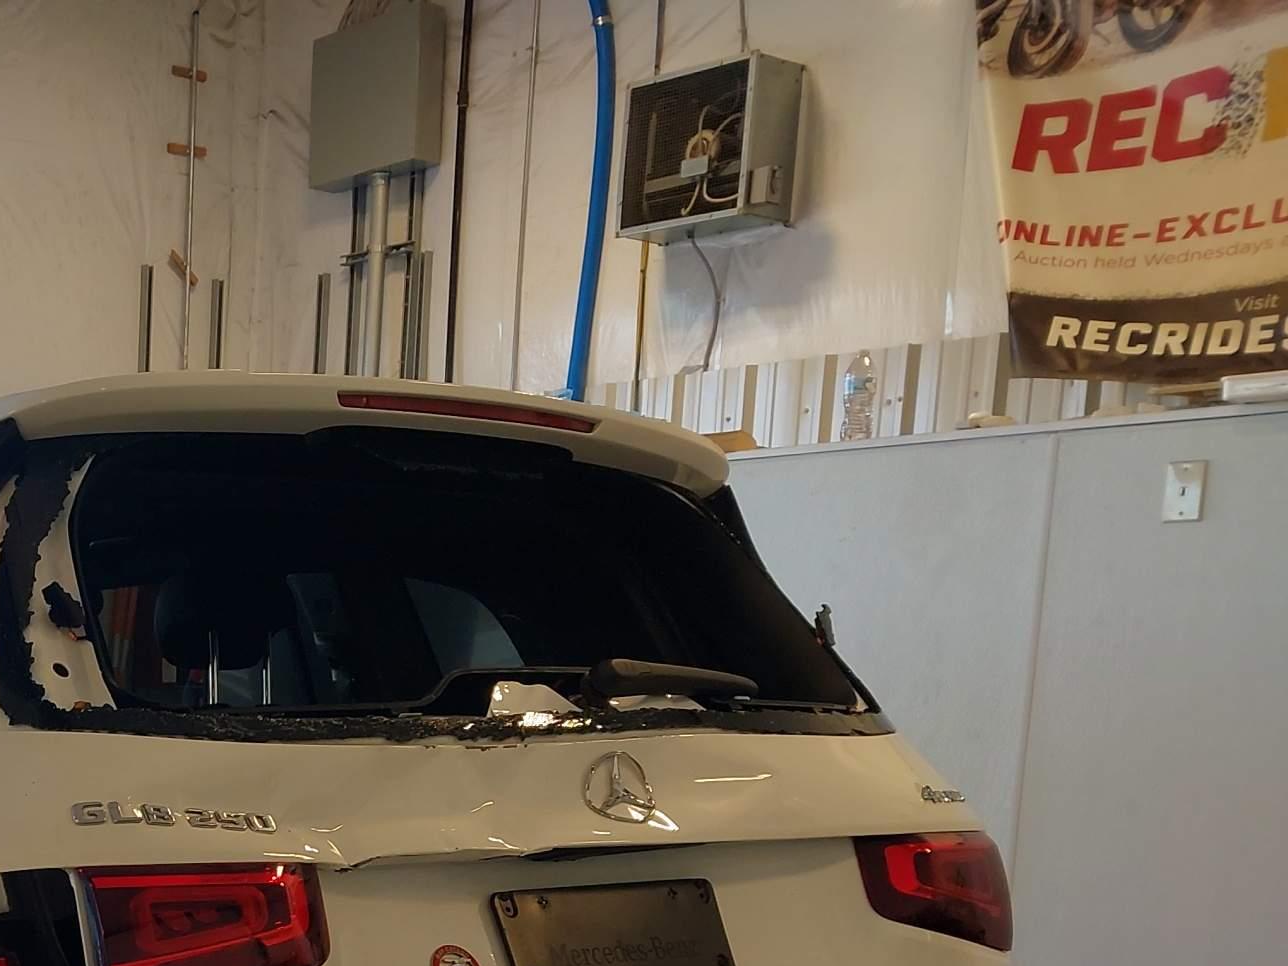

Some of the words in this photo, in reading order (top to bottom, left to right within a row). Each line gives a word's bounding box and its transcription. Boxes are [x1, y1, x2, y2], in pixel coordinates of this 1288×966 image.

[1012, 65, 1233, 174] REC
[1013, 250, 1088, 270] Auction
[1093, 256, 1136, 269] held
[1144, 238, 1273, 267] Wednesdays
[1234, 293, 1279, 313] Visit
[1045, 313, 1288, 357] RECRIDE
[71, 801, 176, 827] GLB
[184, 807, 278, 834] 250
